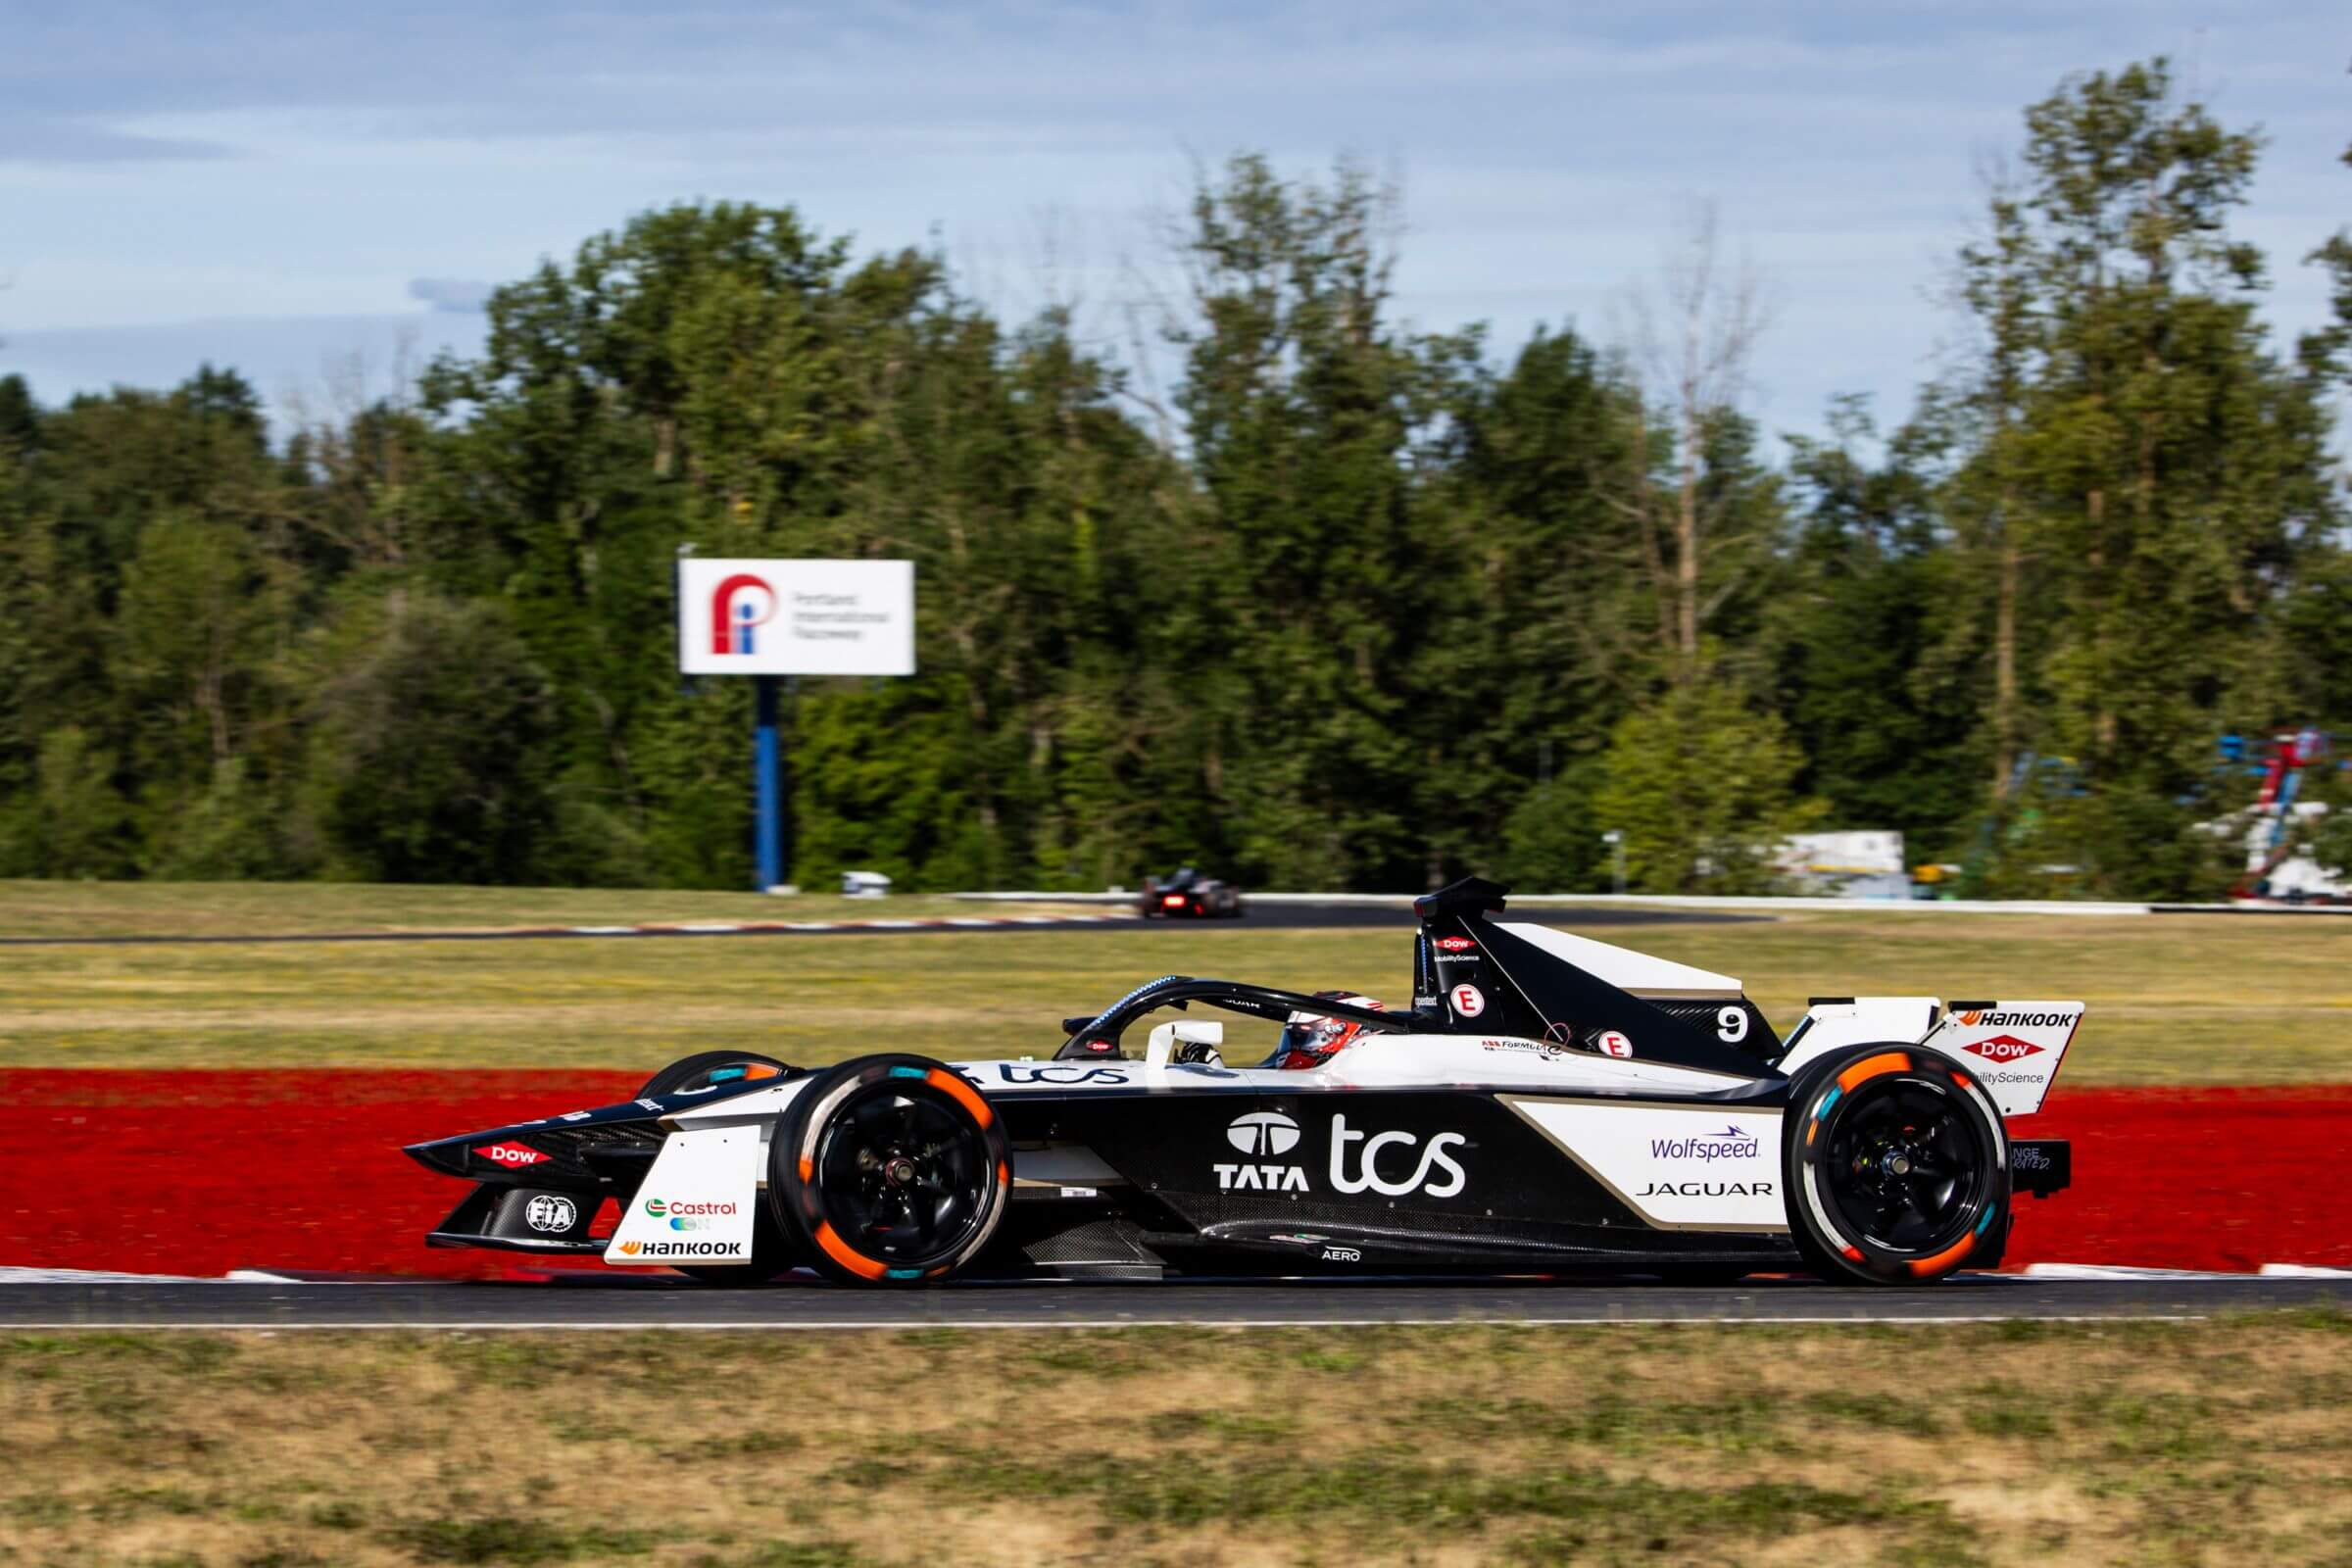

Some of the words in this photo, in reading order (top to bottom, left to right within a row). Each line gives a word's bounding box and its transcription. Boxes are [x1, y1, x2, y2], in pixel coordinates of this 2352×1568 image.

[1459, 991, 1476, 1010] E
[1717, 1006, 1749, 1042] 9
[1607, 1037, 1624, 1056] E
[1981, 1042, 2030, 1056] Dow
[1976, 1072, 2043, 1085] ilityScience
[491, 1147, 537, 1163] Dow
[1329, 1112, 1466, 1198] tcs
[1651, 1138, 1758, 1163] Wolfspeed
[2013, 1148, 2039, 1157] NGE
[1213, 1163, 1309, 1192] TATA
[1636, 1183, 1773, 1197] JAGUAR
[670, 1201, 737, 1215] Castrol
[1321, 1250, 1360, 1262] AERO
